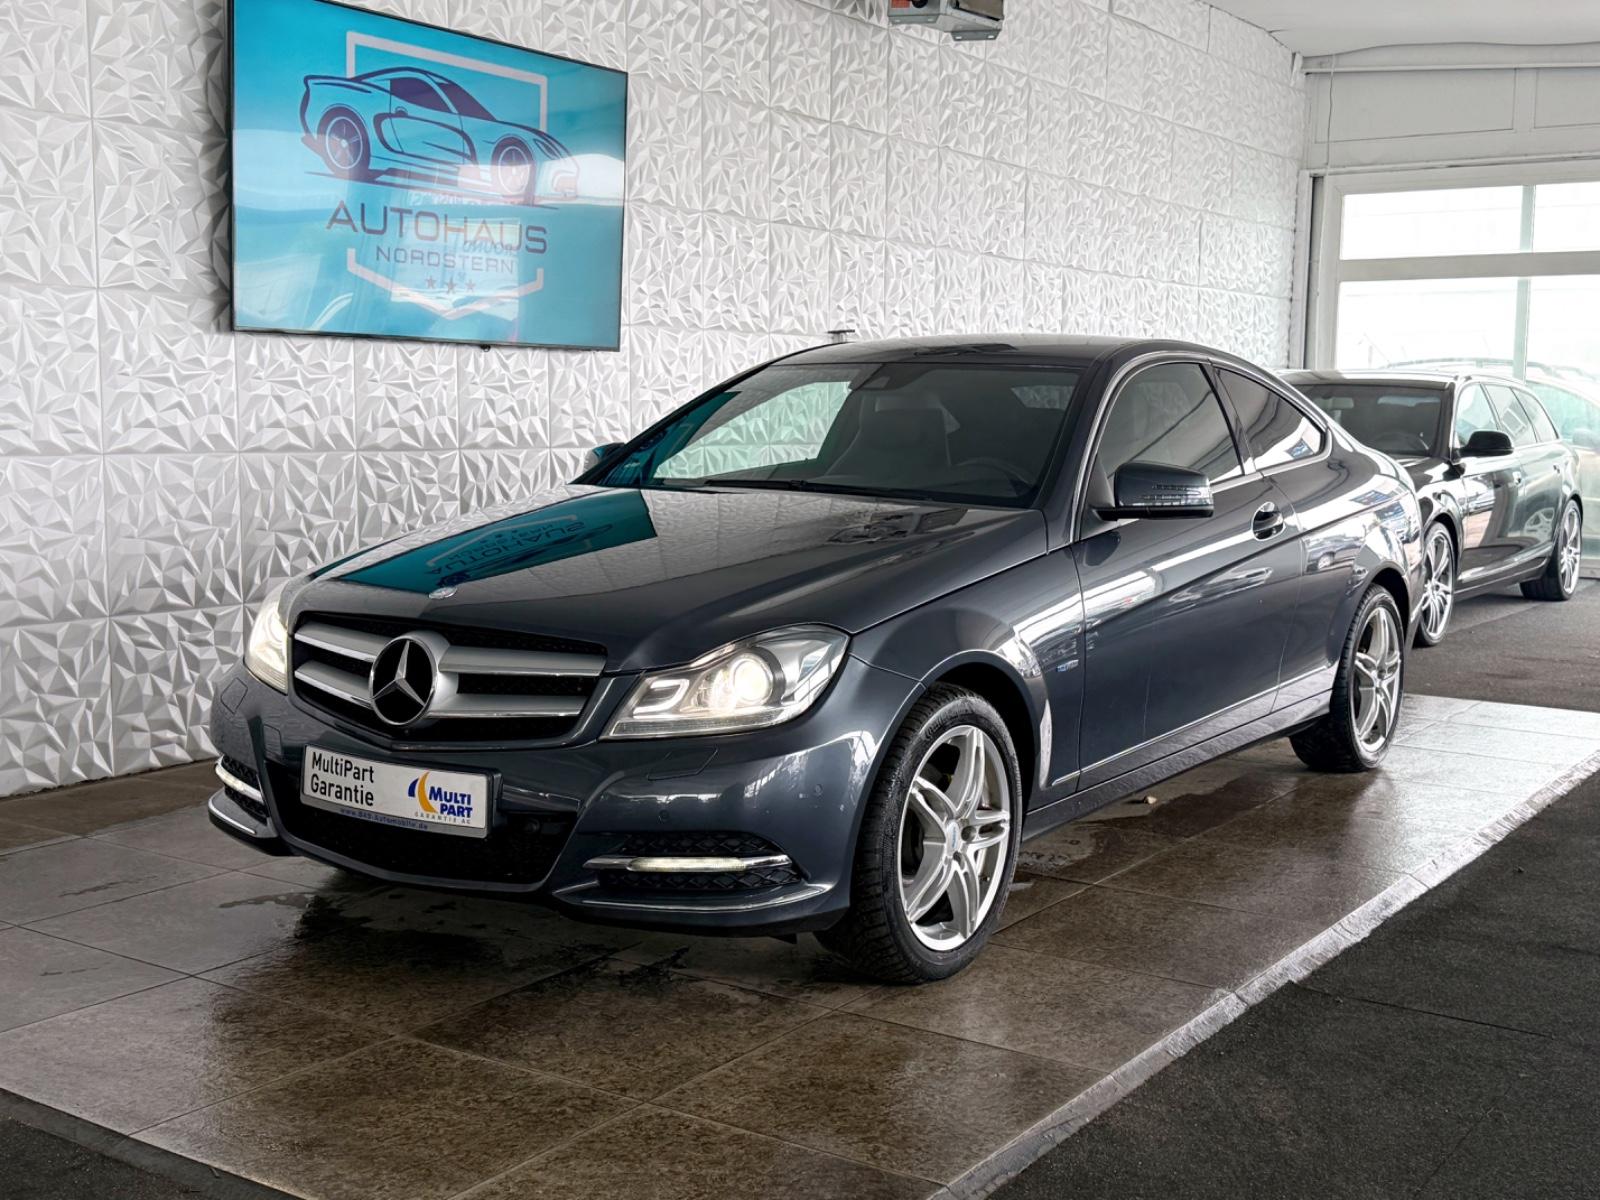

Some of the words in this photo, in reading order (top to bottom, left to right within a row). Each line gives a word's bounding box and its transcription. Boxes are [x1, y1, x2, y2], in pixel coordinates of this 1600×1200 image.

[325, 200, 548, 255] AUTOHAUS
[376, 245, 514, 274] NORDSTERN
[312, 751, 374, 784] MultiPart
[310, 773, 374, 806] Garantie
[414, 811, 457, 823] GARANTIE
[440, 802, 473, 819] PART
